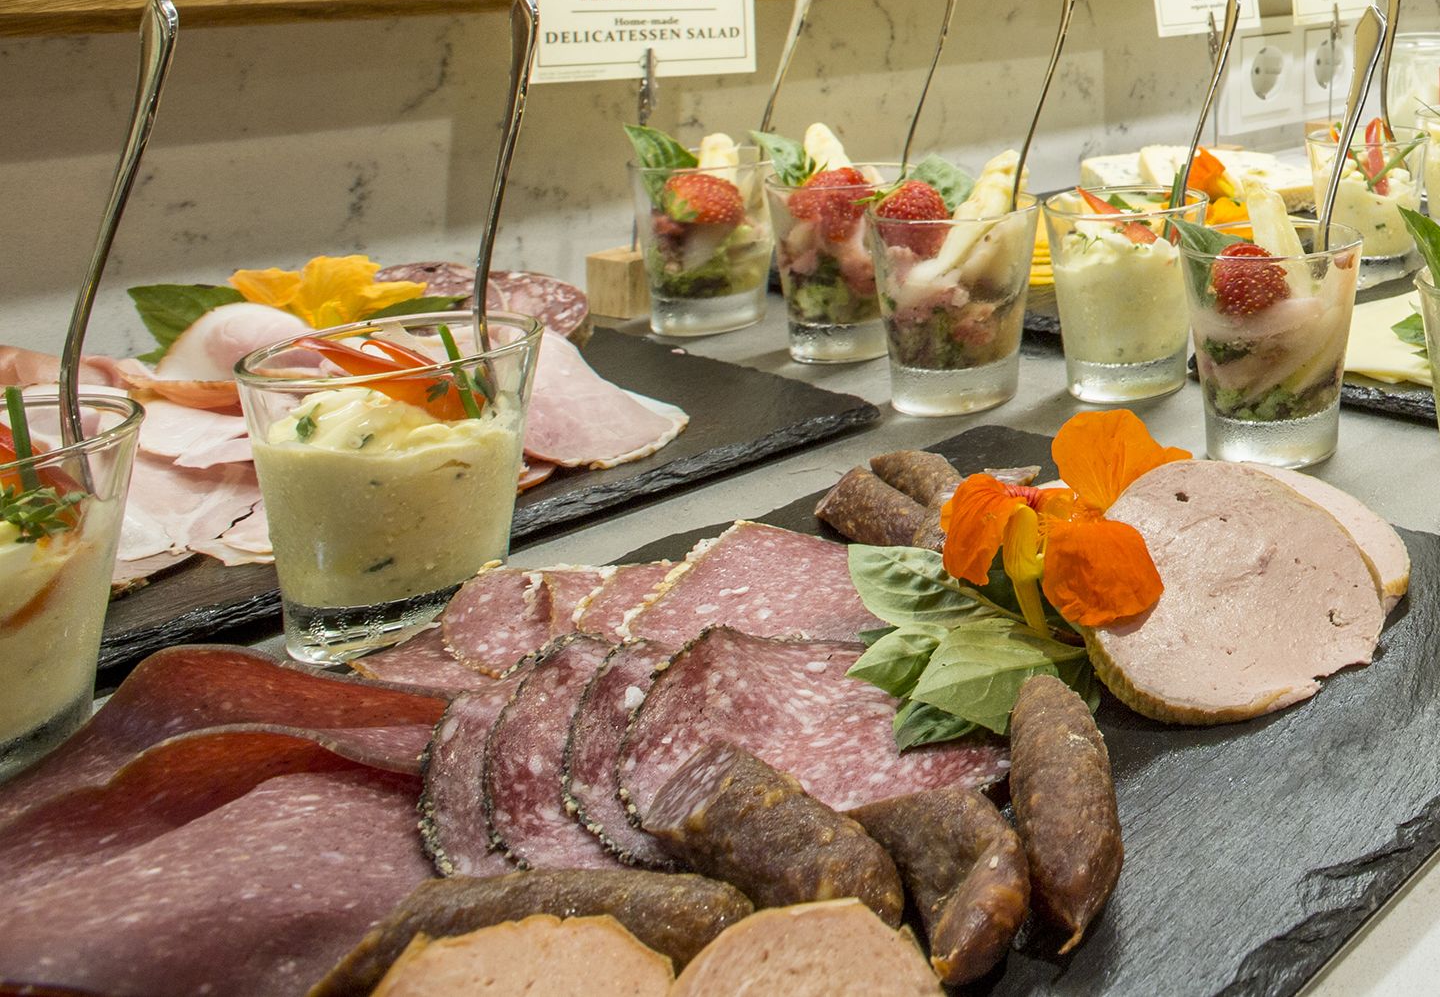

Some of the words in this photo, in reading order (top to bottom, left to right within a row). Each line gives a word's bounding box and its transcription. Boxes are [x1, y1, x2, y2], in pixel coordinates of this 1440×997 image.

[614, 16, 680, 27] Home-made
[545, 28, 682, 44] DELICATESSEN
[687, 26, 741, 39] SALAD
